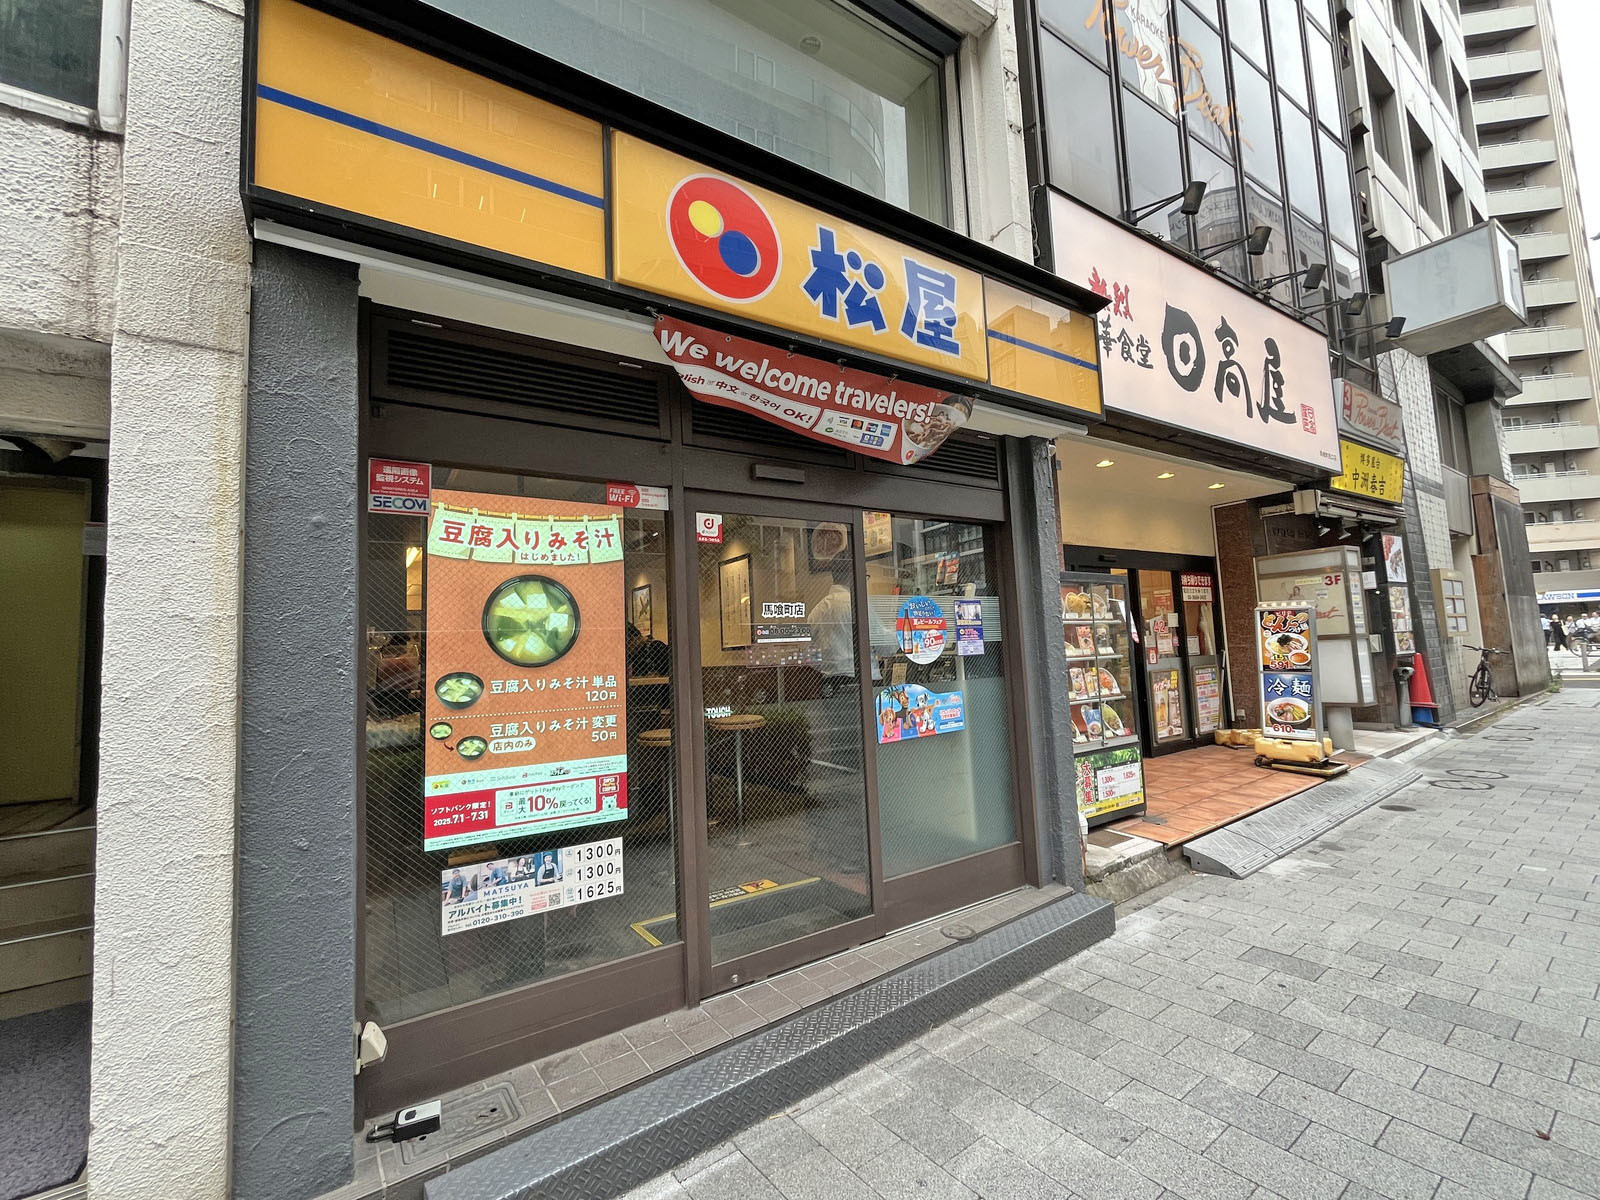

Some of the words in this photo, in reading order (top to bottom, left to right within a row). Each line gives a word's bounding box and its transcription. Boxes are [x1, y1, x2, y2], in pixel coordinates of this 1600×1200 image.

[1130, 8, 1165, 43] KARAOKE
[803, 226, 960, 355] 松屋
[1161, 301, 1297, 423] 日高屋
[660, 329, 709, 360] We
[715, 351, 831, 401] welcome
[834, 382, 935, 424] travelers!
[716, 381, 740, 395] 中文
[749, 393, 782, 411] 한국어
[783, 408, 813, 423] OK!
[376, 473, 424, 485] 監視システム
[372, 495, 427, 511] SECOM
[609, 494, 634, 503] Wi-Fi
[439, 519, 614, 550] 豆腐入りみそ汁
[1325, 575, 1341, 586] 3F
[762, 603, 804, 617] 馬喰町店
[490, 676, 588, 694] 豆腐入りみそ汁
[592, 675, 617, 688] 単品
[1267, 677, 1312, 697] 冷麺
[585, 690, 617, 701] 120円
[705, 706, 731, 719] TOUCH
[489, 717, 588, 737] 豆腐入りみそ汁
[592, 715, 617, 728] 変更
[591, 730, 617, 742] 50円
[492, 739, 533, 751] 店内のみ
[528, 795, 559, 812] 10%
[483, 882, 529, 897] MATSUYA
[448, 895, 522, 919] アルバイト募集中!
[472, 909, 524, 926] 0120-310-390
